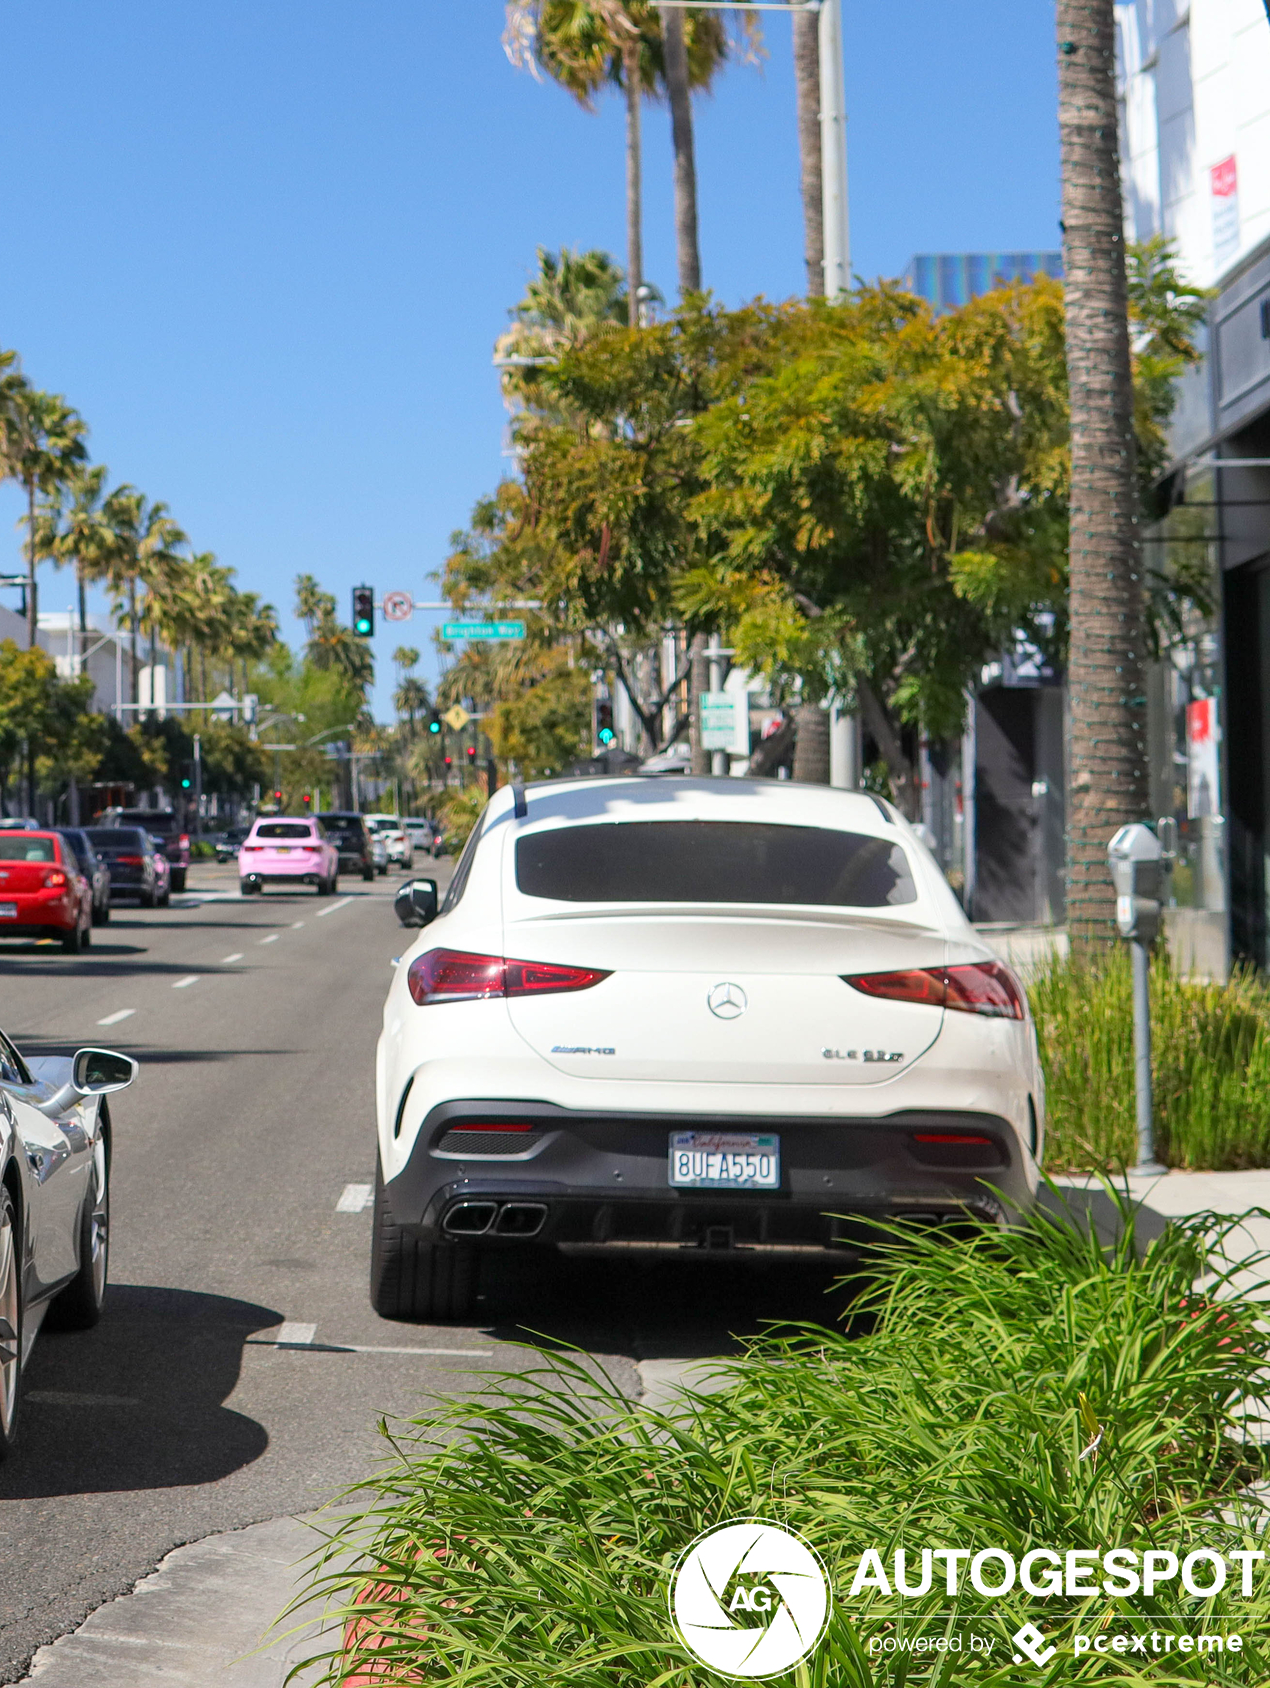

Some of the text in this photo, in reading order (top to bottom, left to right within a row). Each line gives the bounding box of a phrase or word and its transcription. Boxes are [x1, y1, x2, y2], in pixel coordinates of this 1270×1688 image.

[498, 625, 522, 637] Way
[691, 1136, 753, 1151] California
[678, 1152, 771, 1179] 8UFA550
